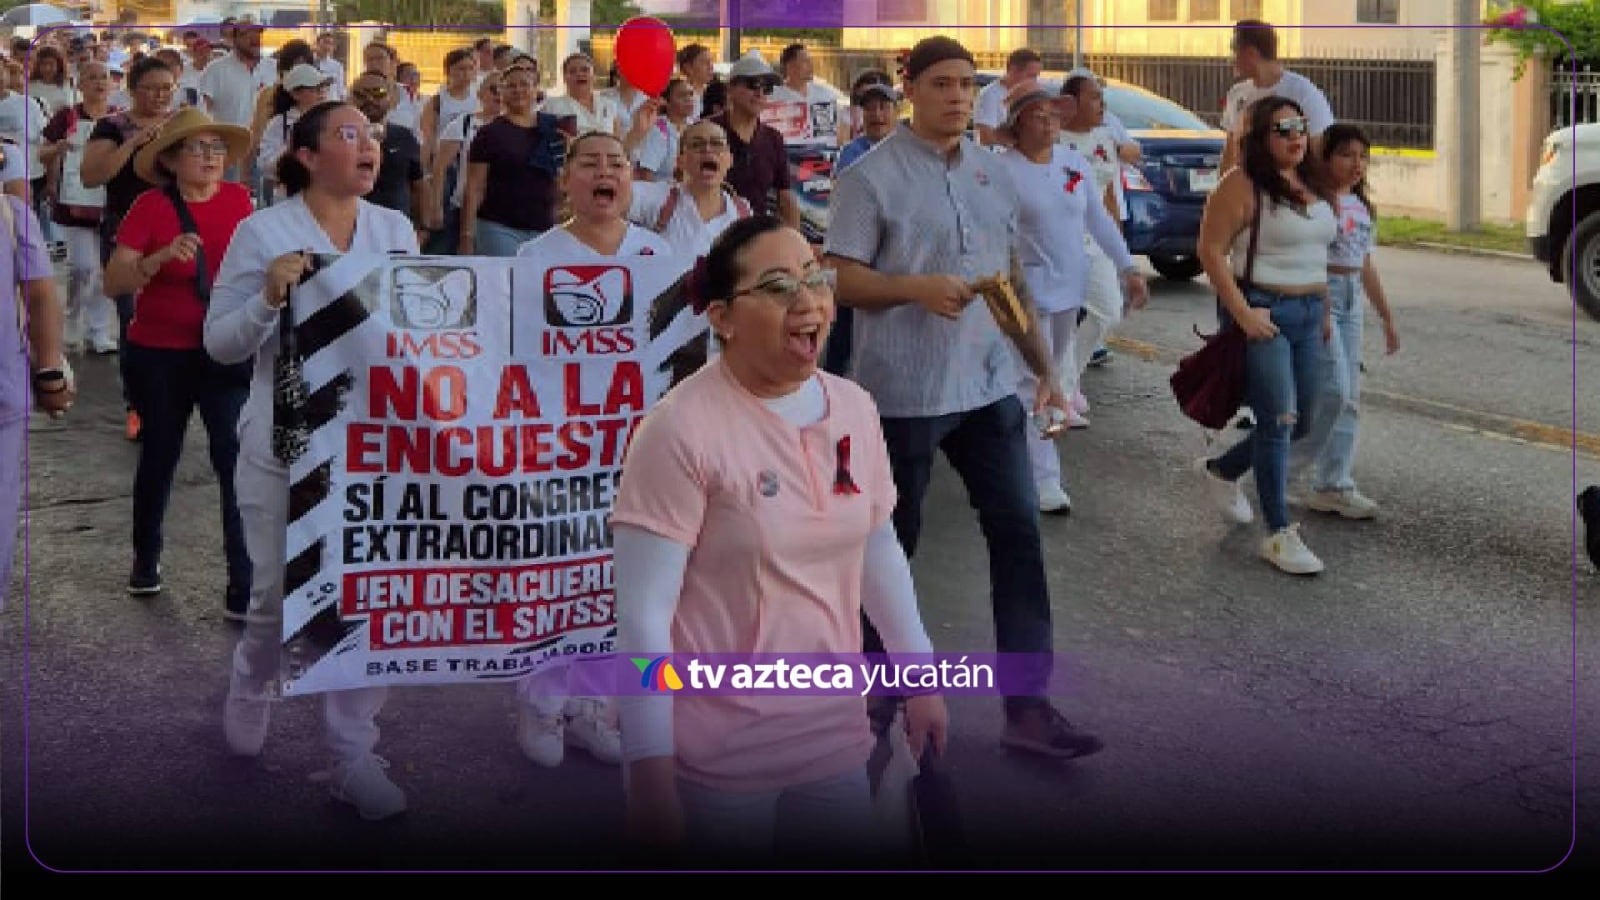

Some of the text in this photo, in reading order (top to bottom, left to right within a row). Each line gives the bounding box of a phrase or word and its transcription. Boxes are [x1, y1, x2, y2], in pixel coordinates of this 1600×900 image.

[386, 331, 482, 359] IMSS
[542, 328, 636, 355] IMSS
[369, 361, 645, 421] NO A LA
[343, 475, 386, 521] SÍ
[396, 482, 448, 521] AL
[382, 609, 451, 643] CON
[466, 606, 504, 640] EL
[366, 658, 438, 676] BASE
